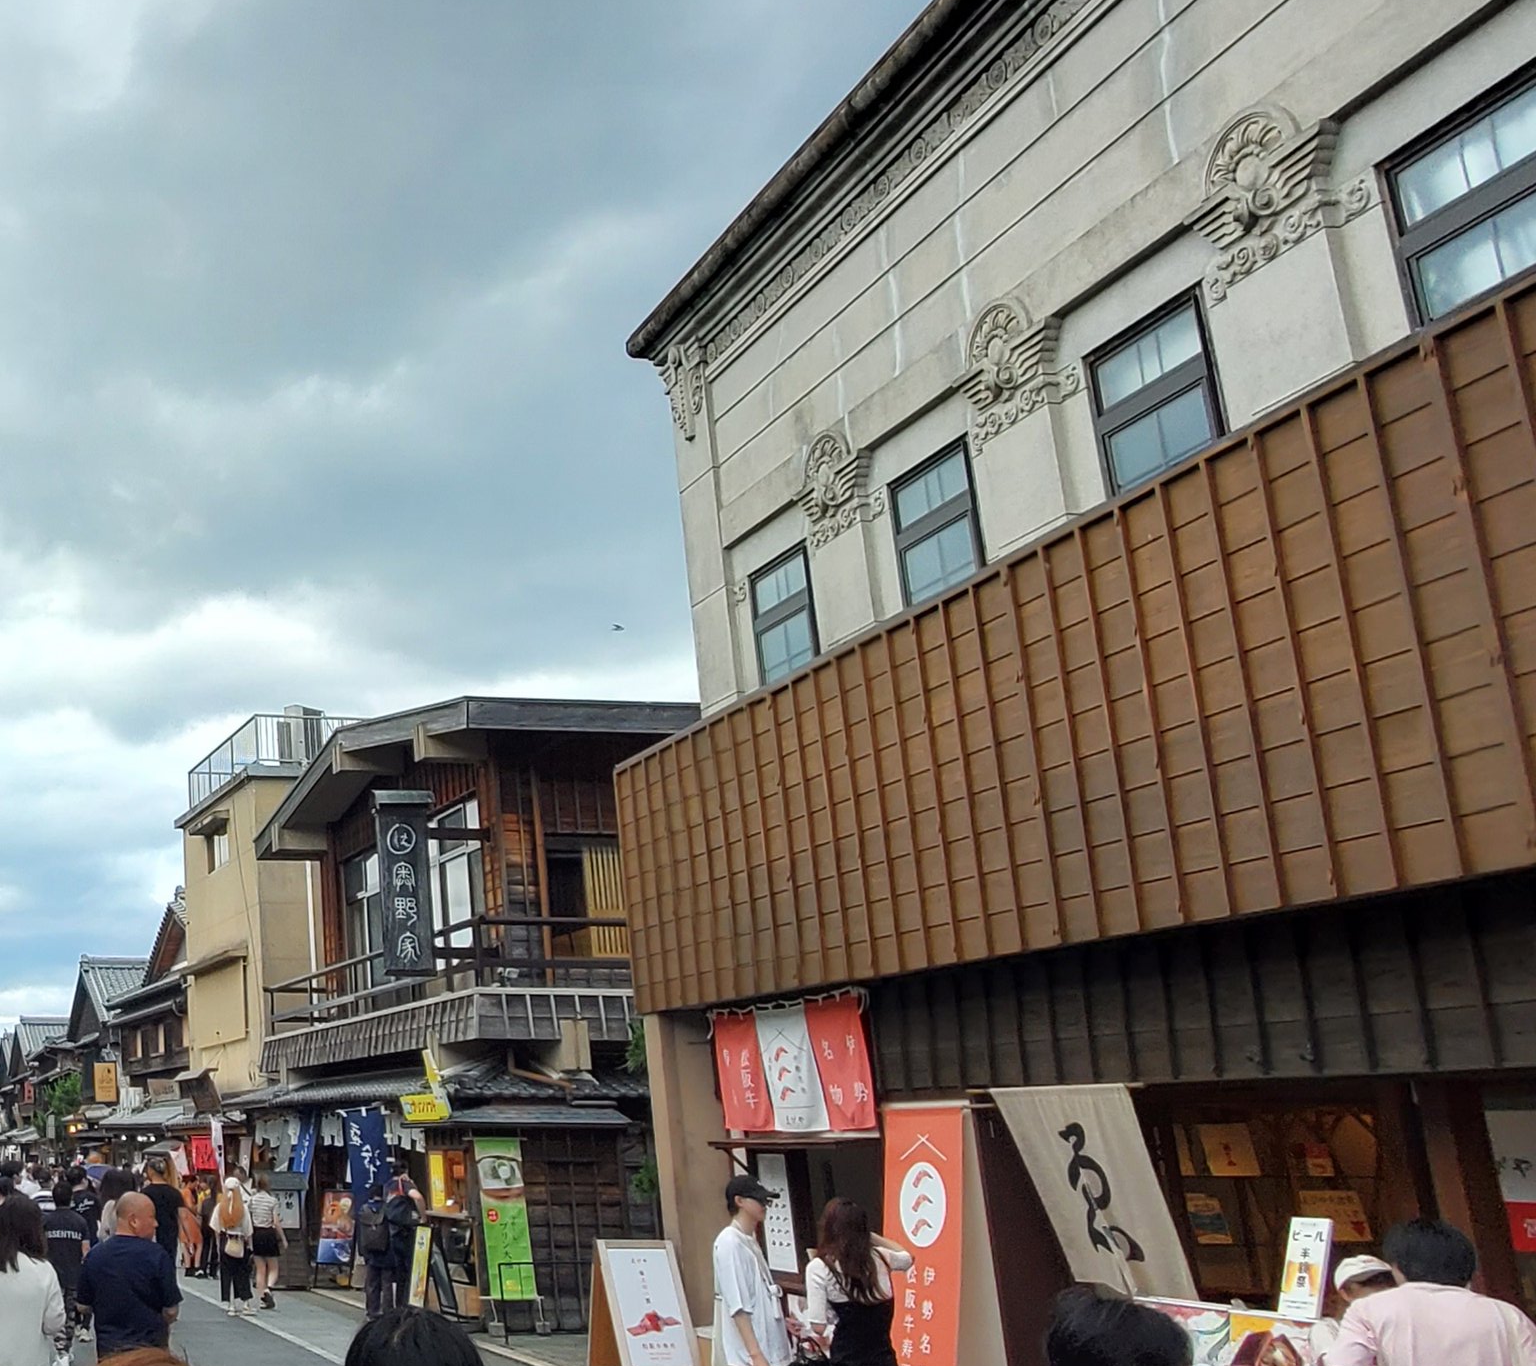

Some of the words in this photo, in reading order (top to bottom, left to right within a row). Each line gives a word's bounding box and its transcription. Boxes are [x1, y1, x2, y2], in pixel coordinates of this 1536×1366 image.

[500, 1221, 514, 1269] プリン大
[1292, 1229, 1325, 1243] ビール
